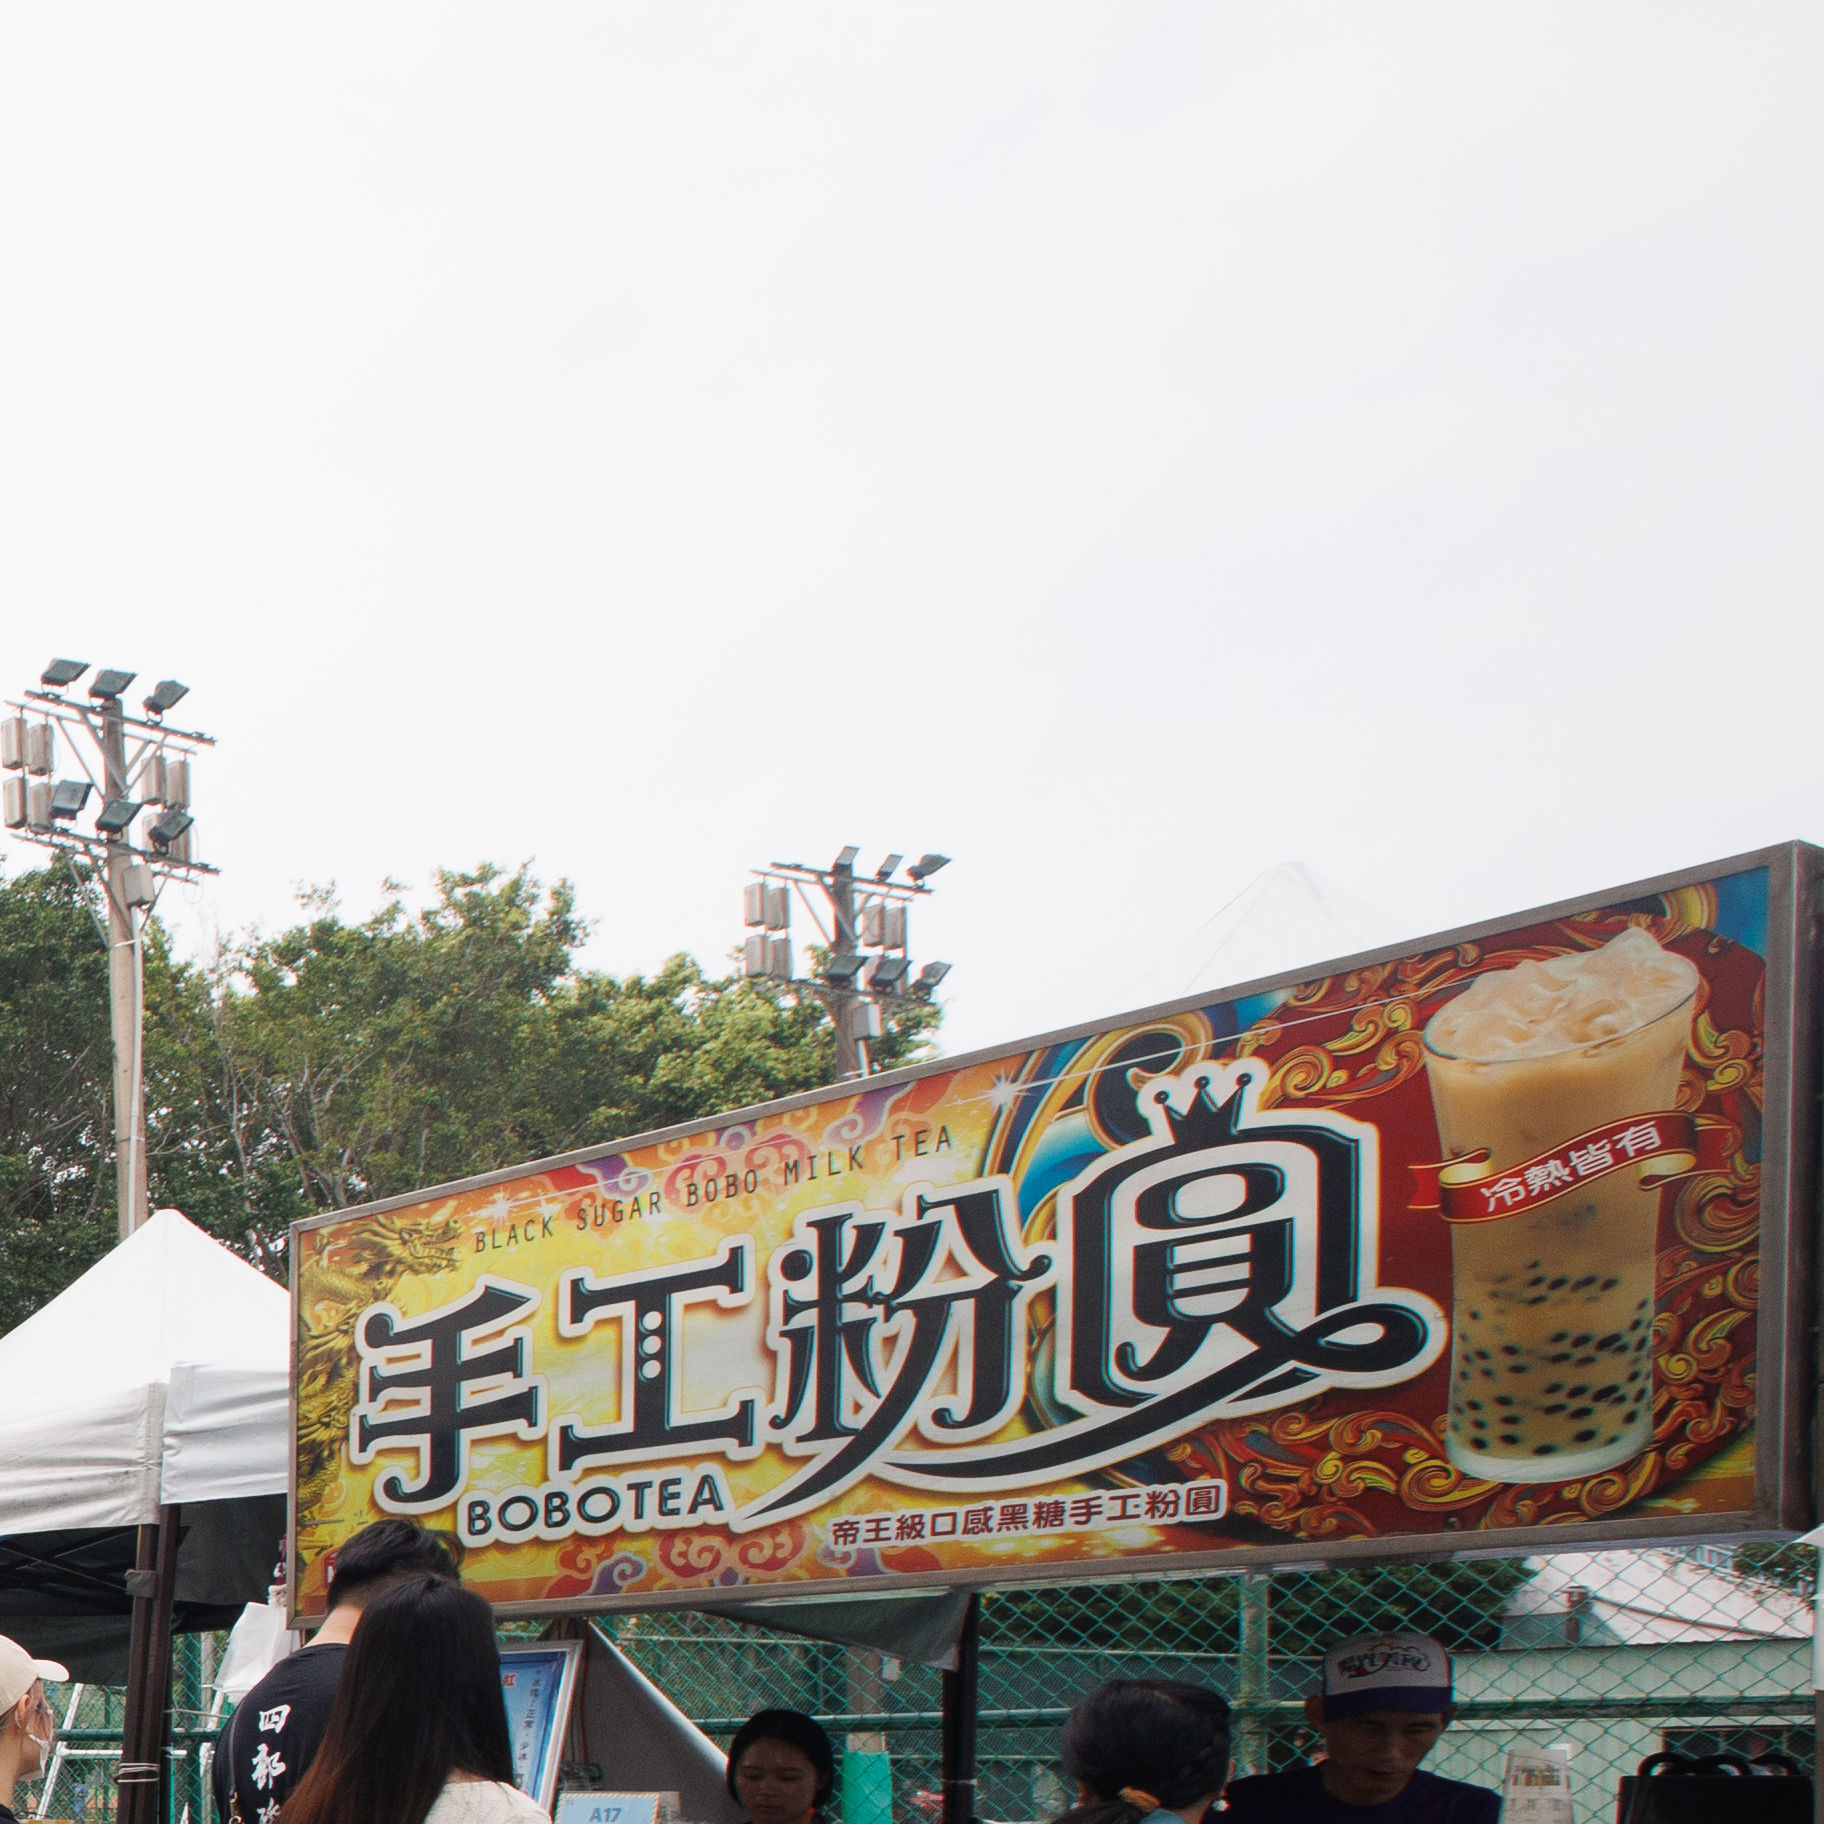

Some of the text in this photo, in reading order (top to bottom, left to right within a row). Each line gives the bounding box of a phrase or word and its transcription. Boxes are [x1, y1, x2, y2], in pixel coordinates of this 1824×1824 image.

[474, 1124, 953, 1255] BLACK SUGAR BOBO MILK TEA
[1480, 1120, 1662, 1213] 冷熱皆有
[467, 1472, 725, 1538] BOBOTEA
[830, 1483, 1222, 1547] 帝王級口感黑糖手工粉圓
[588, 1807, 622, 1823] A17
